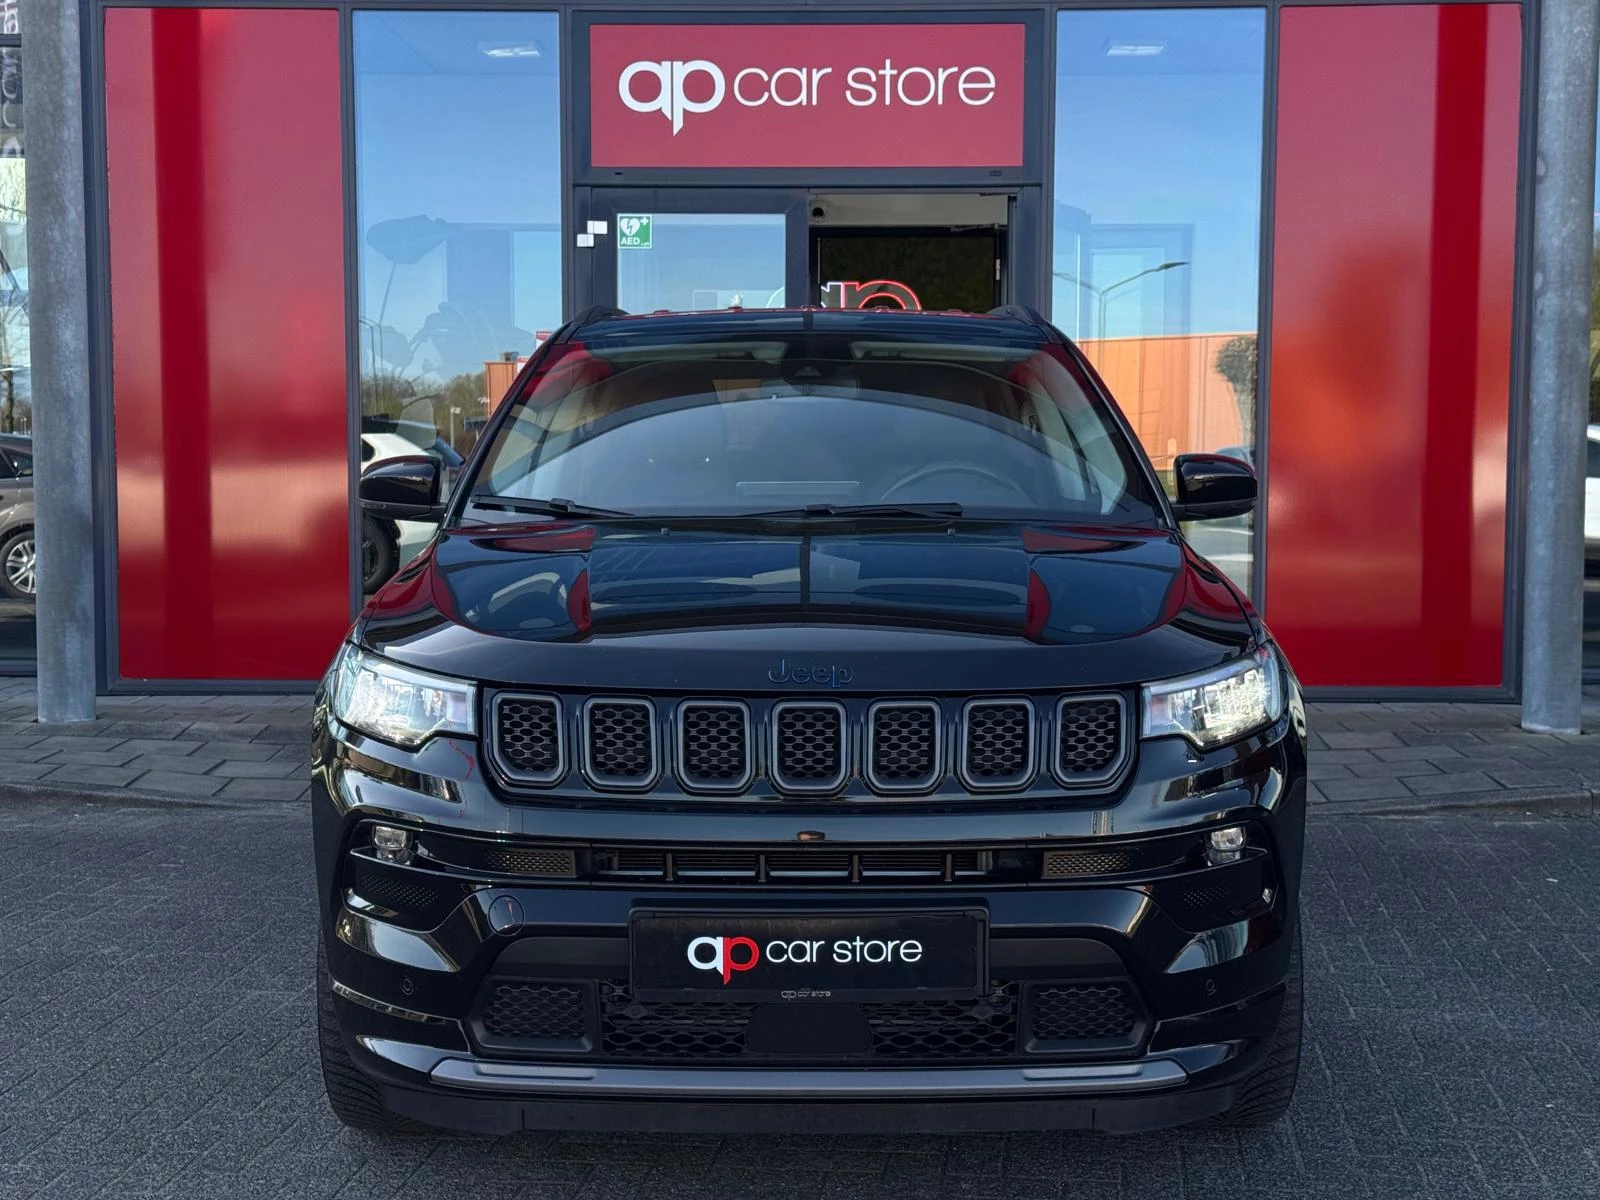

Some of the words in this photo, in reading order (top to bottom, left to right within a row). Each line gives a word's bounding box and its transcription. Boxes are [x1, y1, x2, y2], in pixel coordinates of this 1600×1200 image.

[618, 60, 726, 136] ap
[733, 67, 832, 107] car
[845, 59, 996, 107] store
[620, 236, 641, 246] AED
[768, 659, 853, 688] Jeep
[687, 936, 760, 985] ap
[766, 940, 825, 963] car
[832, 935, 923, 963] store
